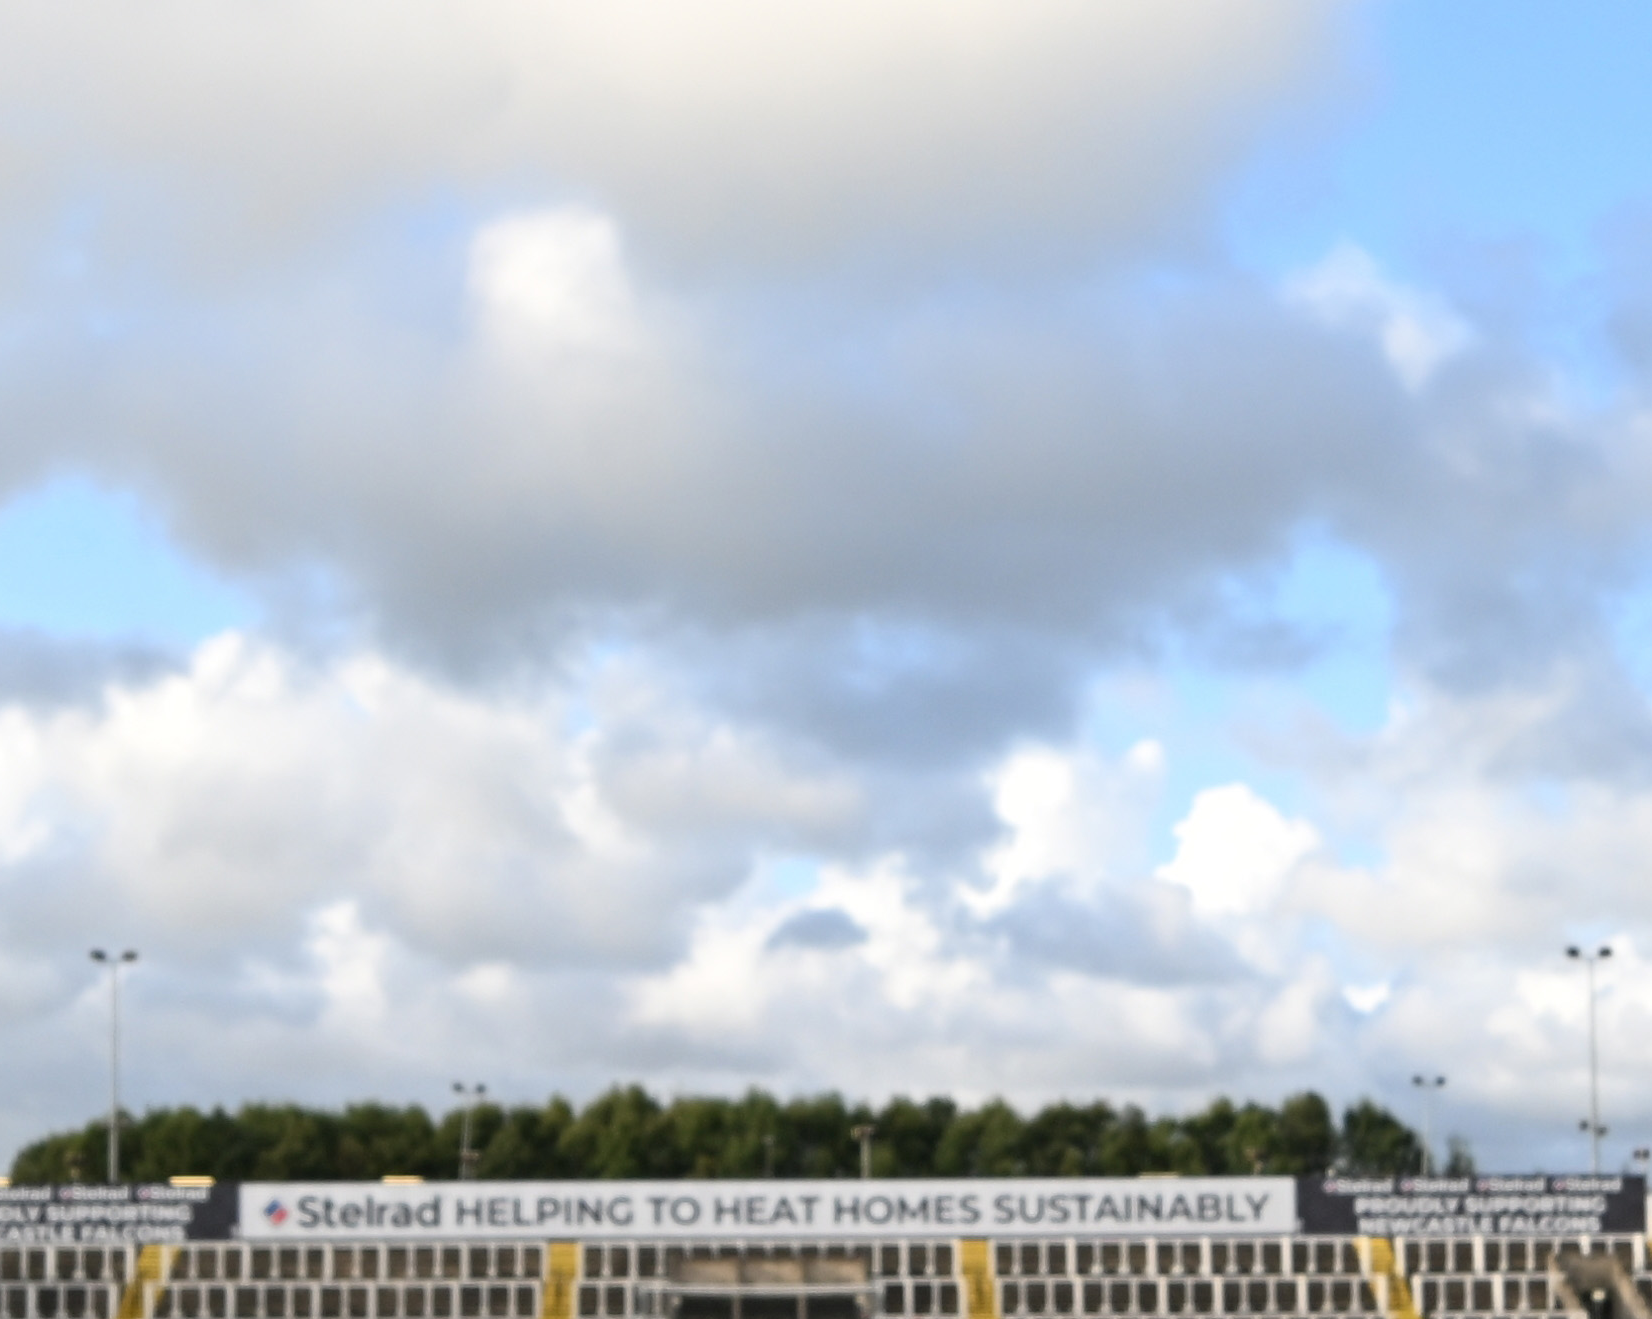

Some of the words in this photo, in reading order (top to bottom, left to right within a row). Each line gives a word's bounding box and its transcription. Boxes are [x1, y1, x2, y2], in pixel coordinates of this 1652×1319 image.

[47, 1203, 193, 1222] SUPPORTING
[298, 1195, 440, 1228] Stelrad
[455, 1196, 634, 1227] HELPING
[646, 1196, 699, 1227] TO
[714, 1195, 820, 1225] HEAT
[833, 1194, 981, 1225] HOMES
[992, 1192, 1271, 1224] SUSTAINABLY
[1465, 1195, 1606, 1213] SUPPORTING
